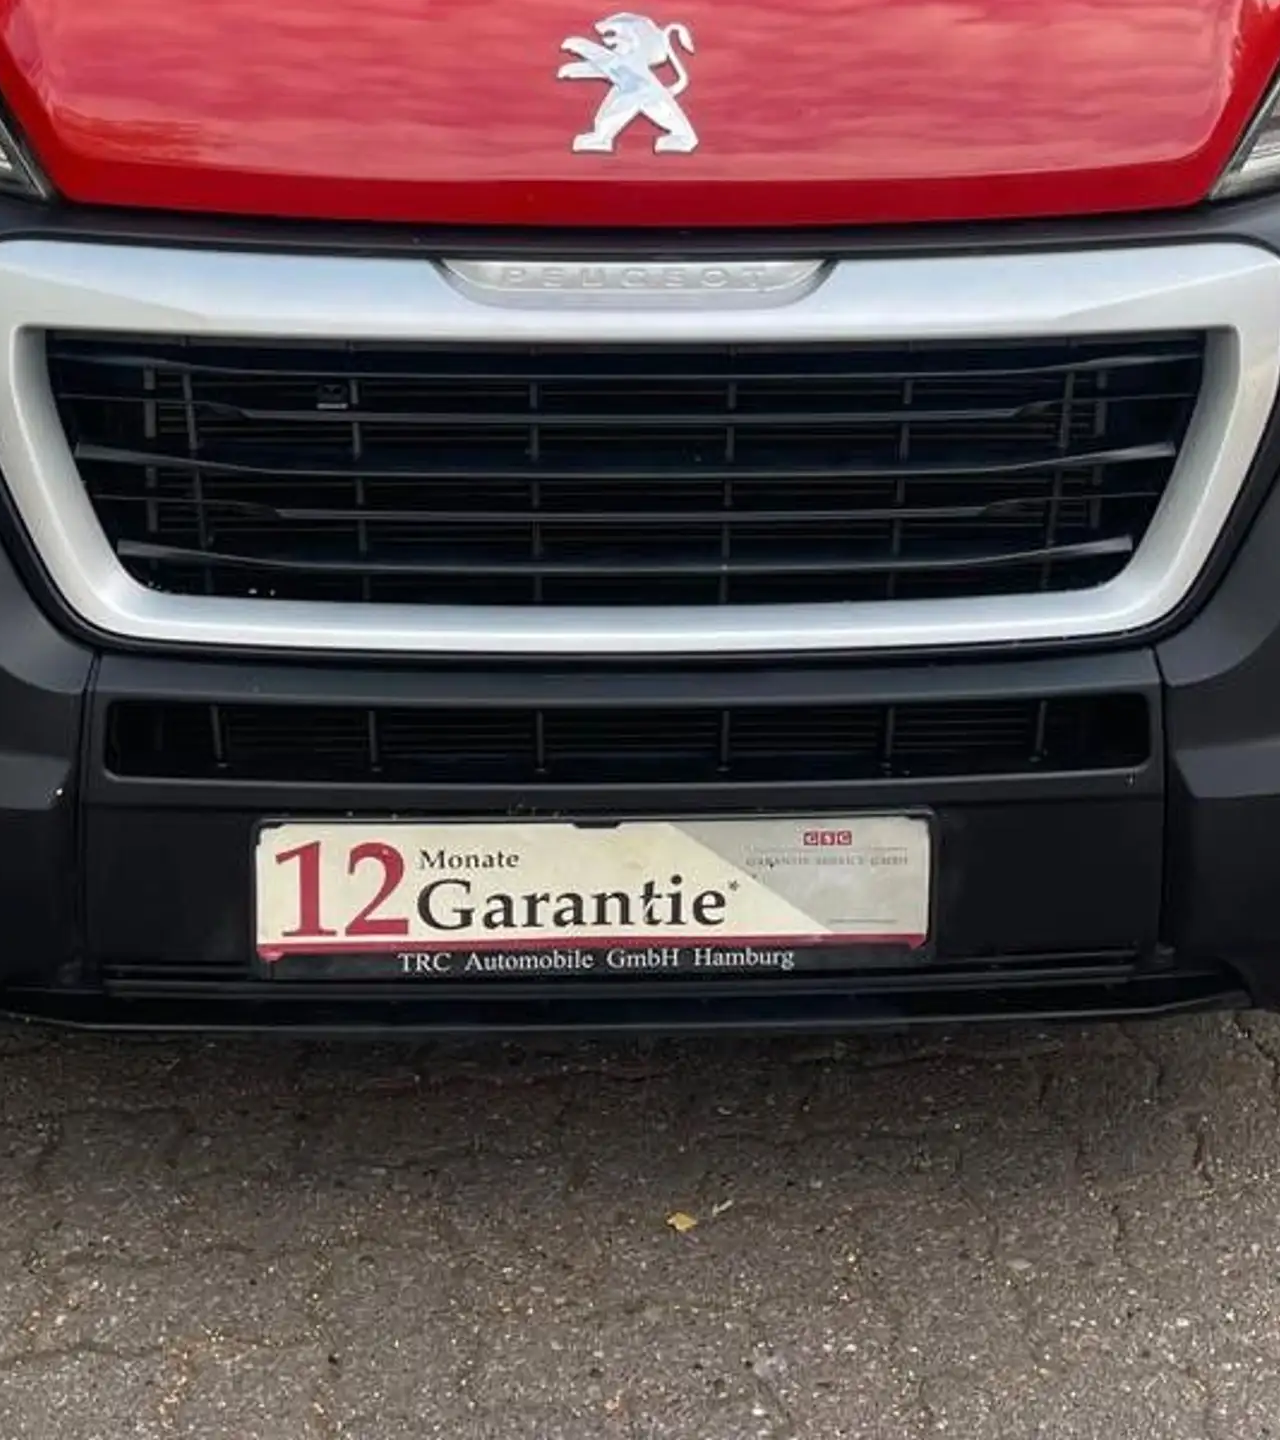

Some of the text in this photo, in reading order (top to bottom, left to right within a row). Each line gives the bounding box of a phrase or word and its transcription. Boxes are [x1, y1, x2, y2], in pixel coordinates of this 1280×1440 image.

[501, 265, 767, 289] PEUGEOT
[419, 849, 520, 870] Monate
[275, 841, 410, 937] 12
[397, 946, 796, 972] TRC Automobile GmbH Hamburg
